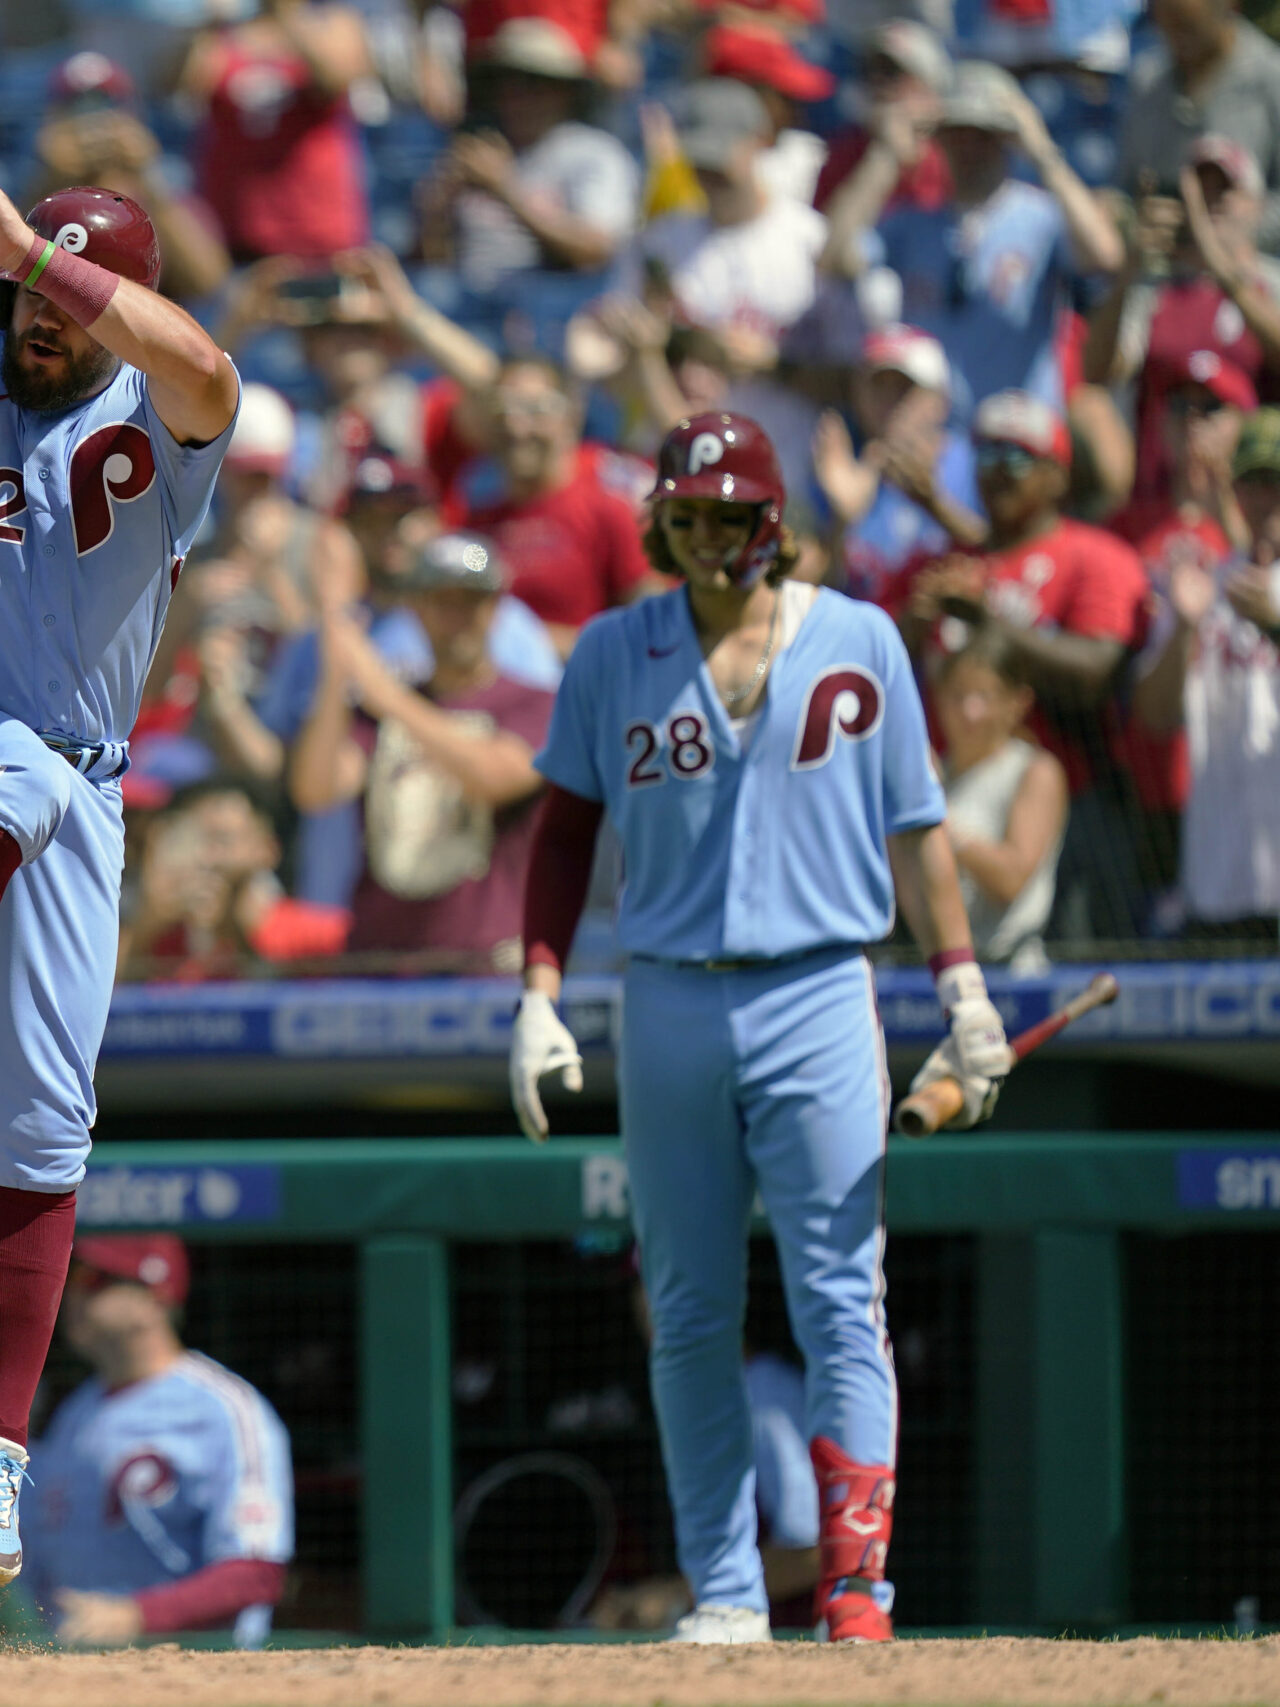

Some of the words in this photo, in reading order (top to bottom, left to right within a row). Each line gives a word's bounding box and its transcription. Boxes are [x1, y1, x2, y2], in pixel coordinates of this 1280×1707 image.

[68, 420, 157, 558] P
[687, 431, 724, 477] P
[624, 709, 716, 789] 28
[789, 661, 887, 773] P
